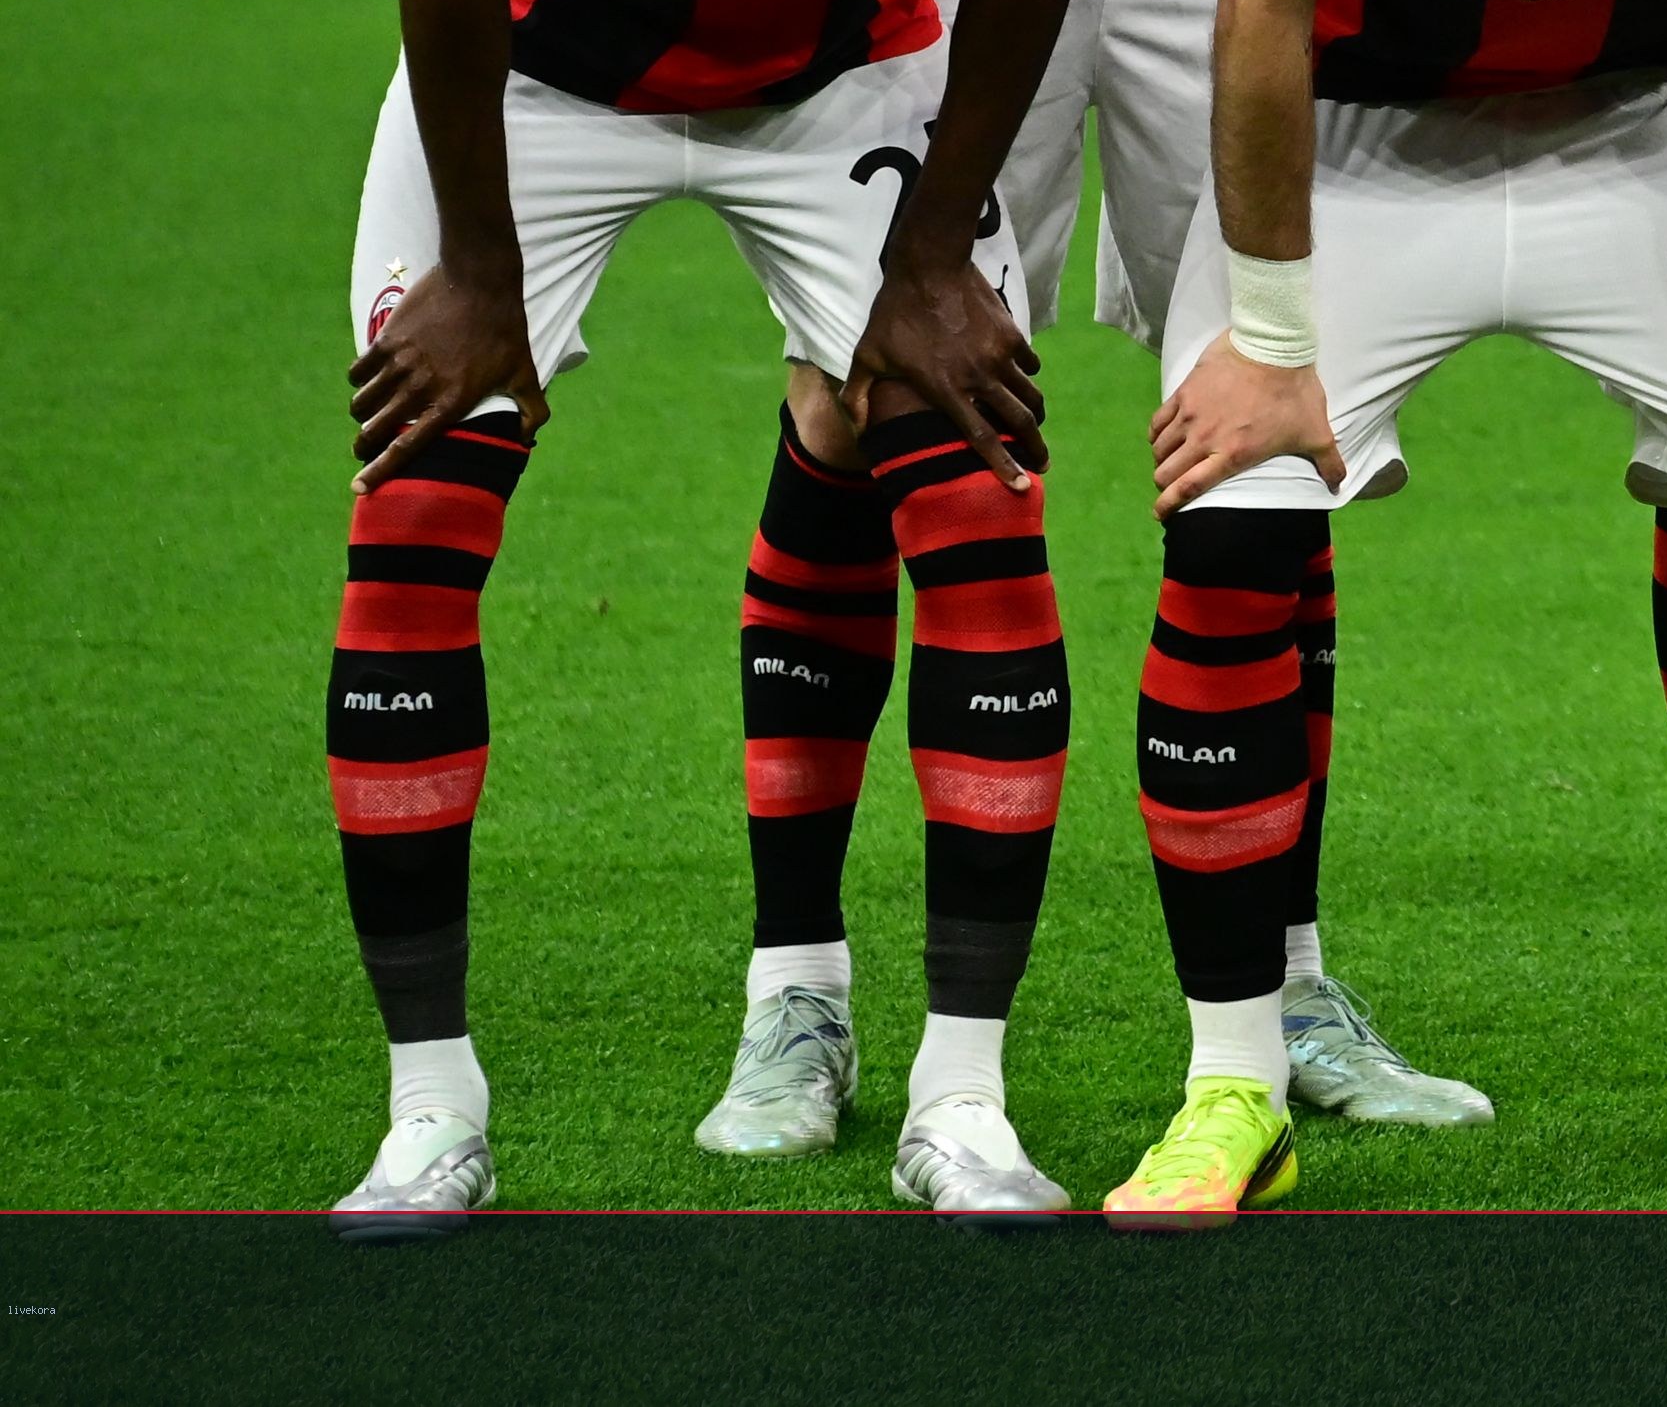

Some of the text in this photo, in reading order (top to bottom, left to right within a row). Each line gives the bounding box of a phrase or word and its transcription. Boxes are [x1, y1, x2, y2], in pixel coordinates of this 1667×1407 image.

[344, 692, 434, 712] MILAN
[969, 688, 1059, 714] MILAN
[1147, 737, 1236, 764] MILAN
